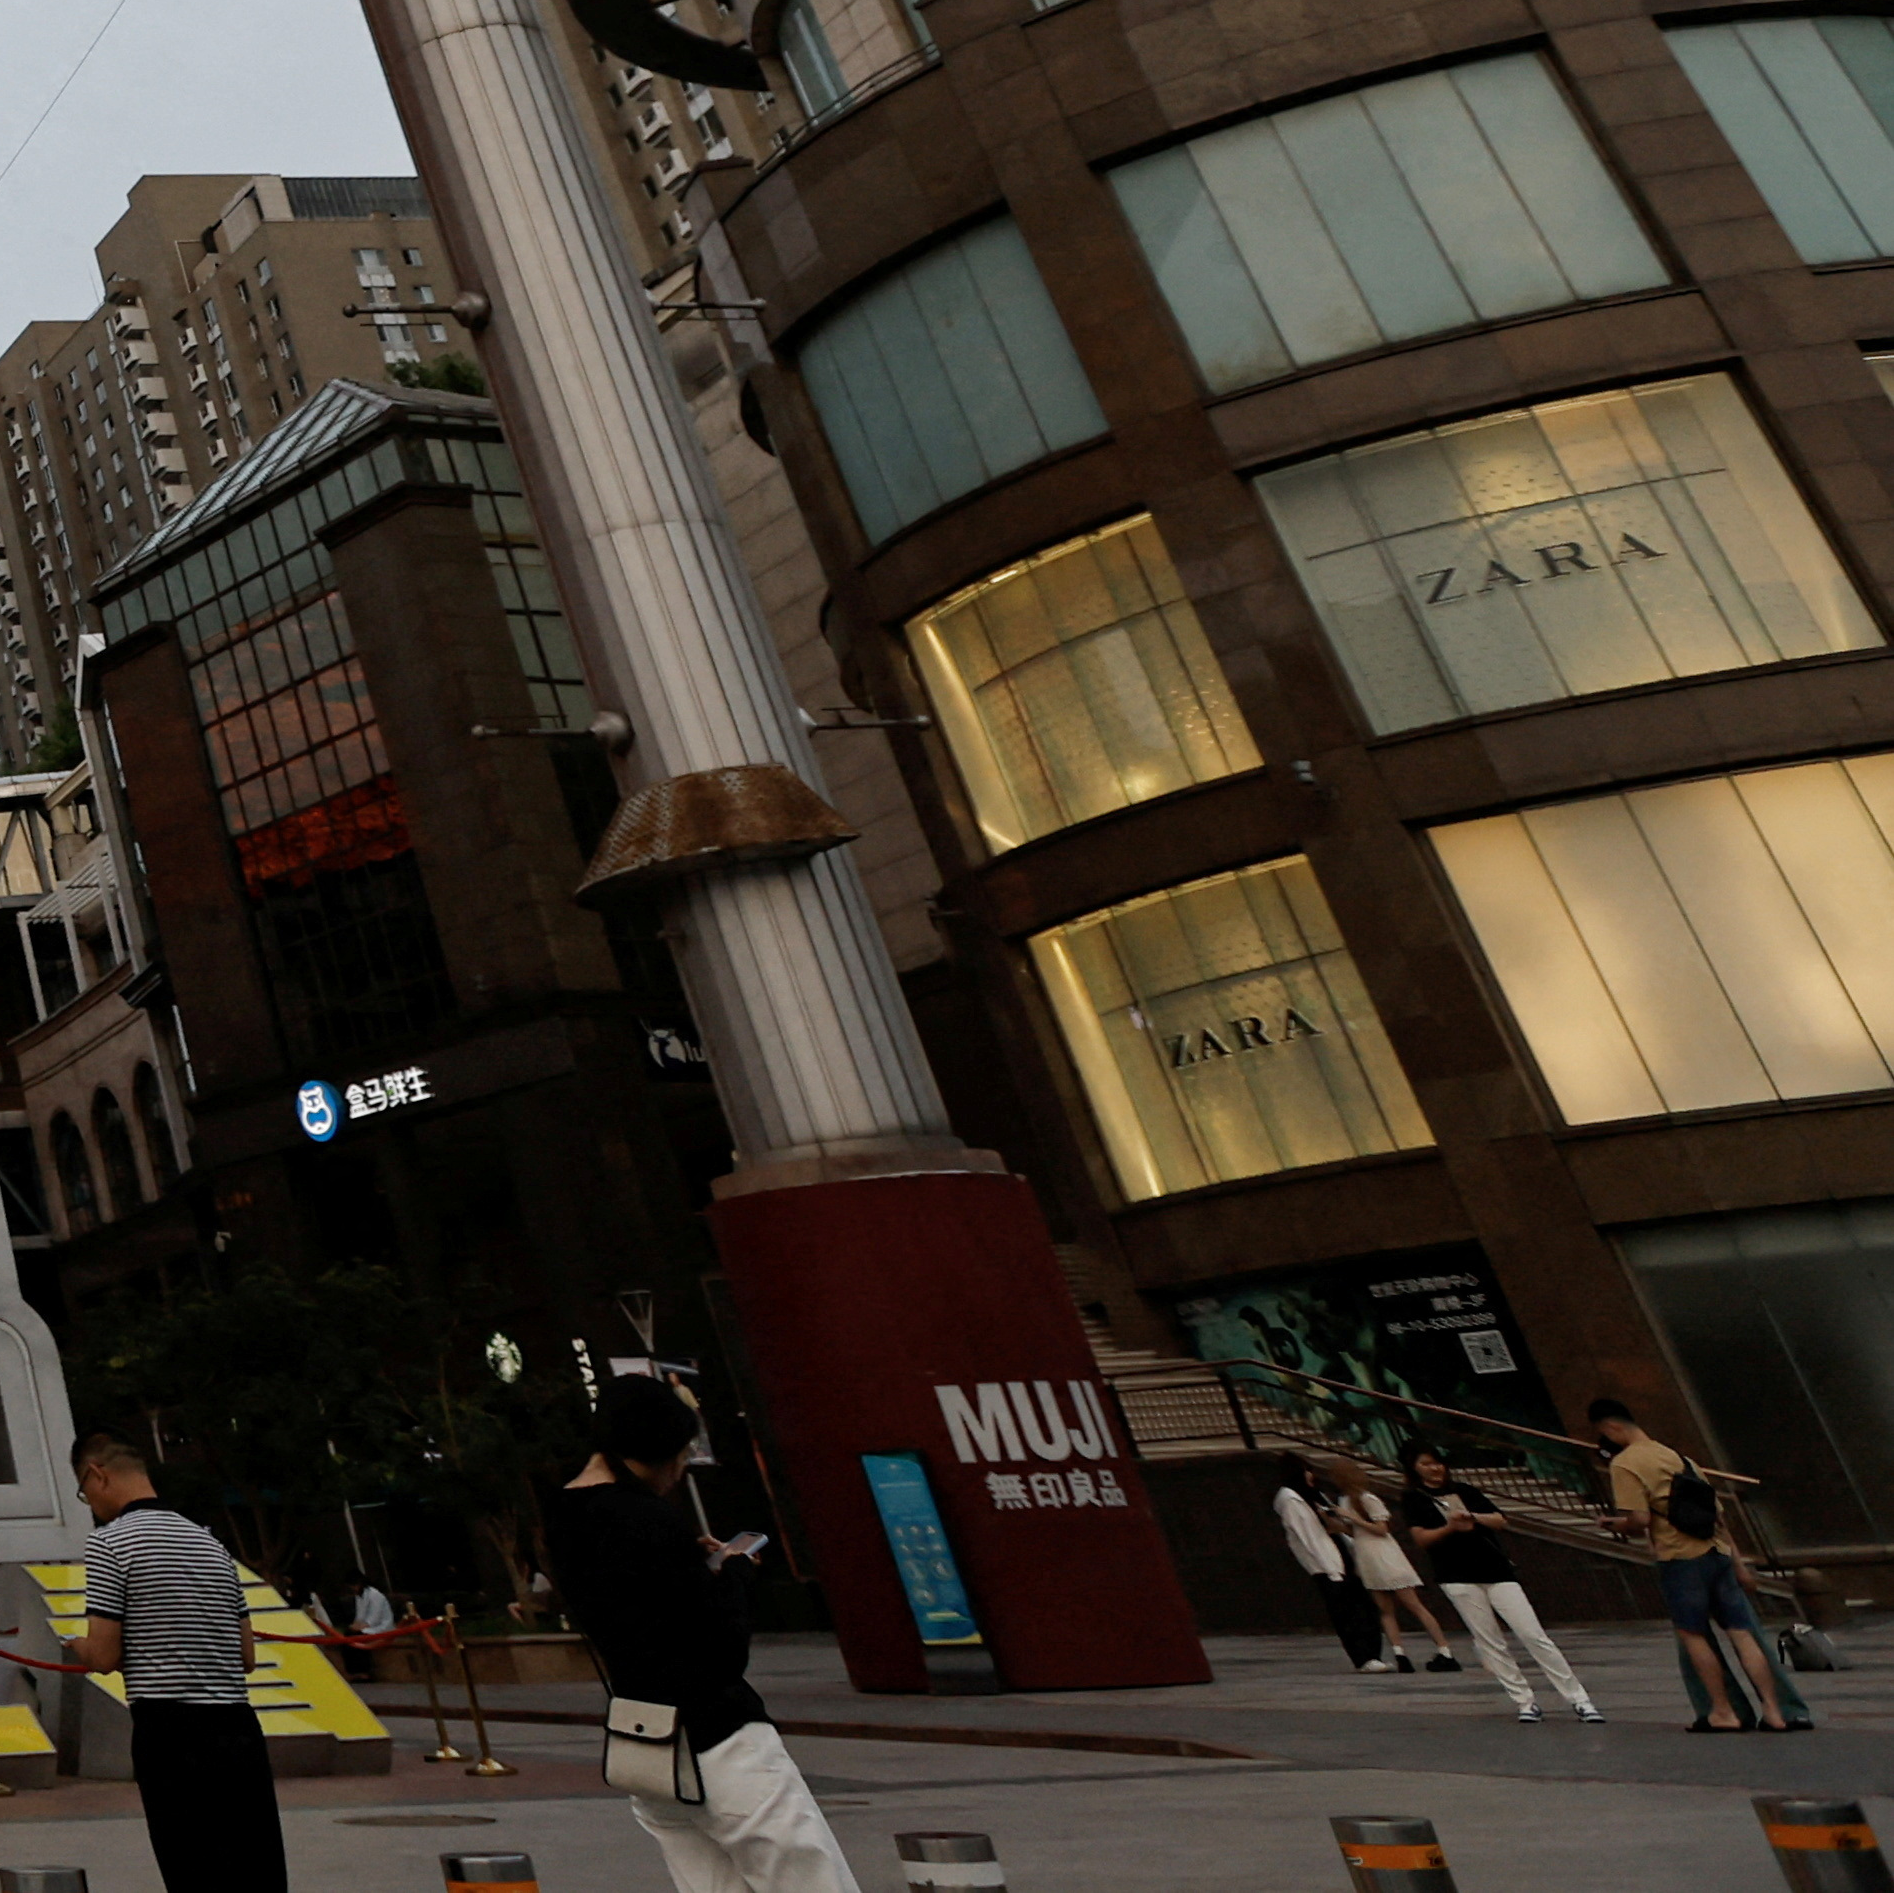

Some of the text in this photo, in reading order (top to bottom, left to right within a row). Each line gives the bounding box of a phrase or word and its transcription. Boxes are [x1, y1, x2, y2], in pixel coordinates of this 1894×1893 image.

[1417, 532, 1668, 604] ZARA
[1162, 1007, 1324, 1069] ZARA
[345, 1066, 433, 1119] 盒马鲜生
[933, 1379, 1119, 1464] MUJI
[984, 1467, 1129, 1510] 無印良品
